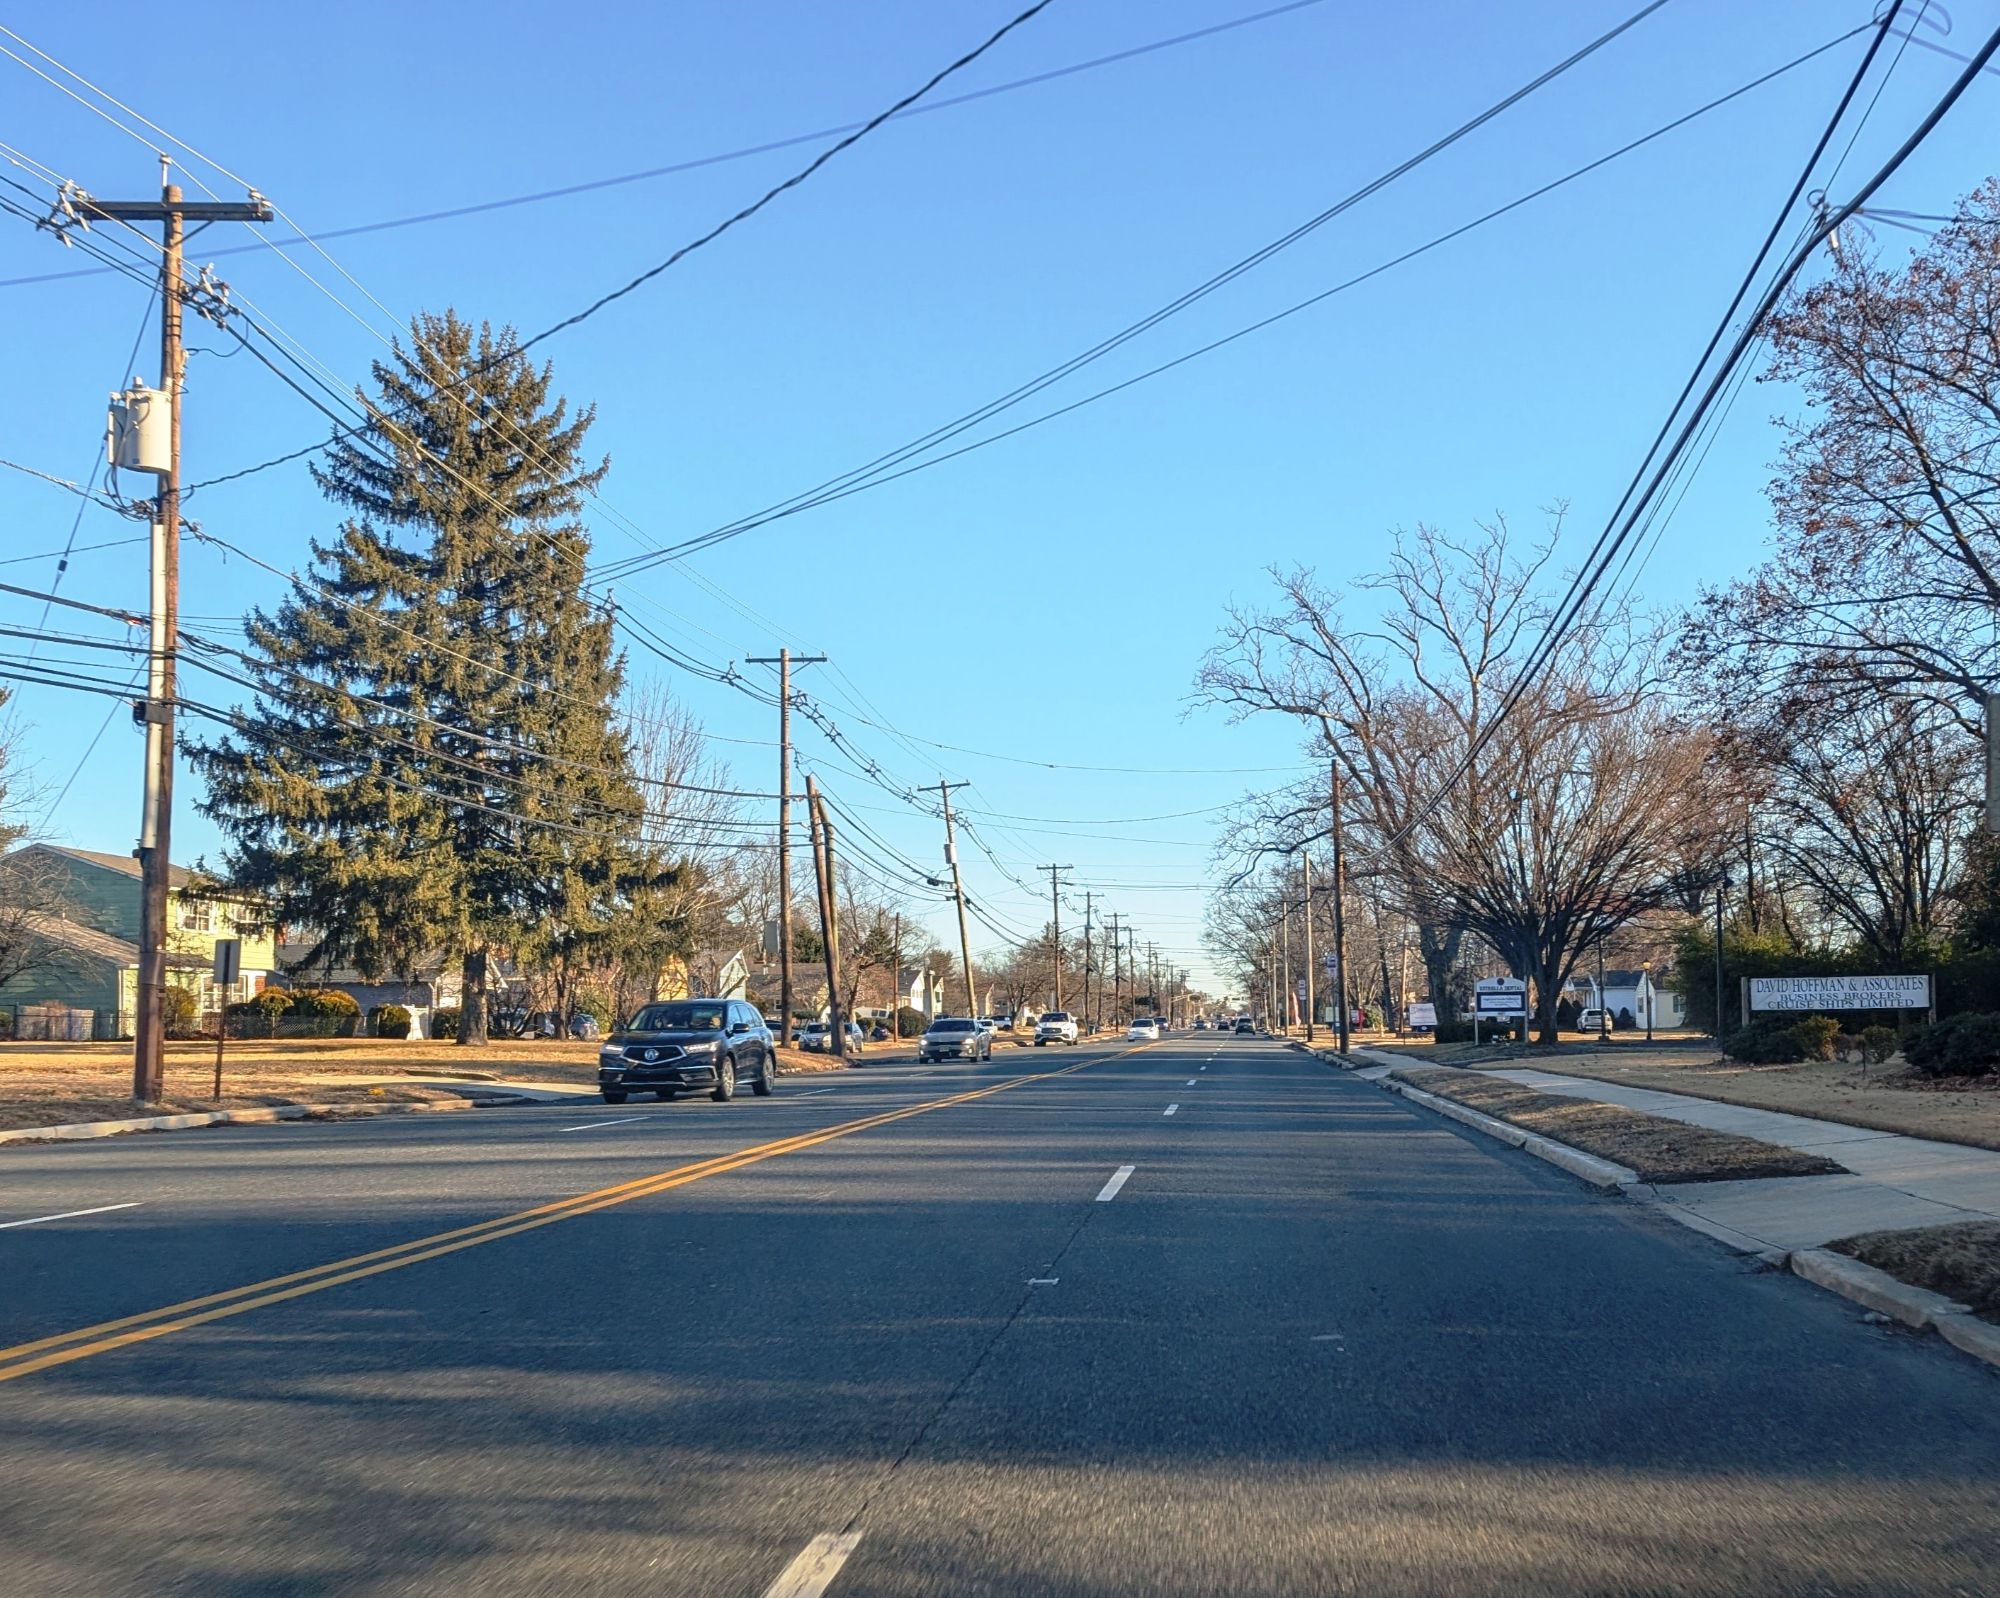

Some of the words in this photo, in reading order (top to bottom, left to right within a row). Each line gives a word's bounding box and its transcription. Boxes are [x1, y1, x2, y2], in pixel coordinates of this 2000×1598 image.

[1757, 979, 1788, 993] DAVID
[1793, 978, 1844, 992] HOFFMAN
[1848, 978, 1858, 991] &
[1862, 977, 1924, 991] ASSOCIATES
[1780, 992, 1839, 1001] BUSINESS
[1844, 991, 1902, 1000] BROKERS
[1768, 1000, 1814, 1009] CRUISE
[1819, 999, 1855, 1008] SHIPS
[1860, 998, 1915, 1008] LIMITED
